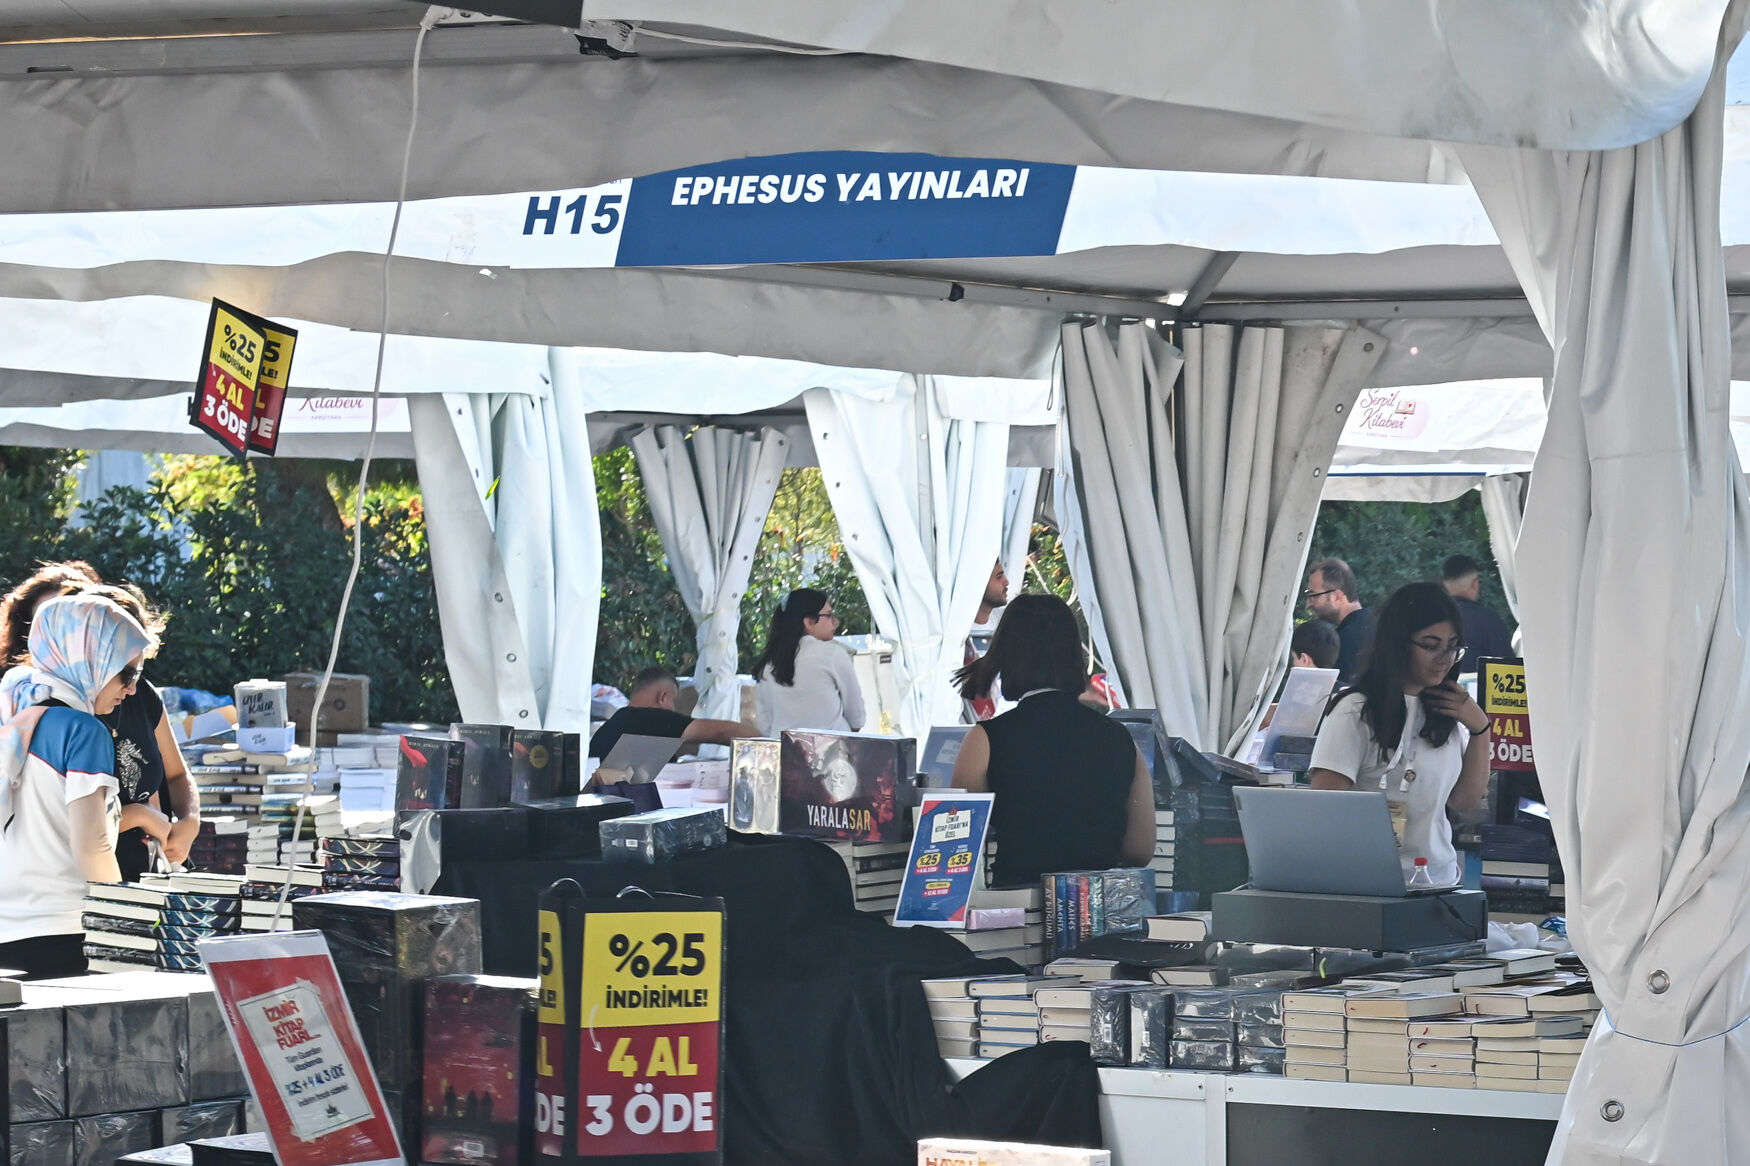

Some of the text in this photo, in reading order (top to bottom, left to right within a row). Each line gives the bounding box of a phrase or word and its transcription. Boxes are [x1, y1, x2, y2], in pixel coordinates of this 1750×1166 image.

[671, 168, 1030, 206] EPHESUS YAYINLARI
[522, 194, 622, 235] H15
[224, 324, 257, 363] %25
[219, 347, 252, 381] İNDİRİMLE!
[215, 374, 244, 411] 4 AL
[1360, 388, 1401, 412] Serpil
[204, 395, 216, 418] 3
[216, 400, 247, 442] ÖDE
[1360, 408, 1407, 429] Kitabevi
[1492, 673, 1526, 693] %25
[1493, 718, 1523, 737] 4 AL
[1497, 738, 1533, 762] ÖDE
[807, 804, 871, 831] YARALASAR
[920, 854, 938, 866] %25
[609, 932, 706, 978] %25
[262, 1000, 300, 1023] İZMİR
[606, 985, 708, 1008] İNDİRİMLE!
[273, 1018, 305, 1038] KİTAP
[608, 1036, 698, 1077] 4 AL
[536, 1092, 565, 1136] DE
[585, 1083, 714, 1136] 3 ÖDE
